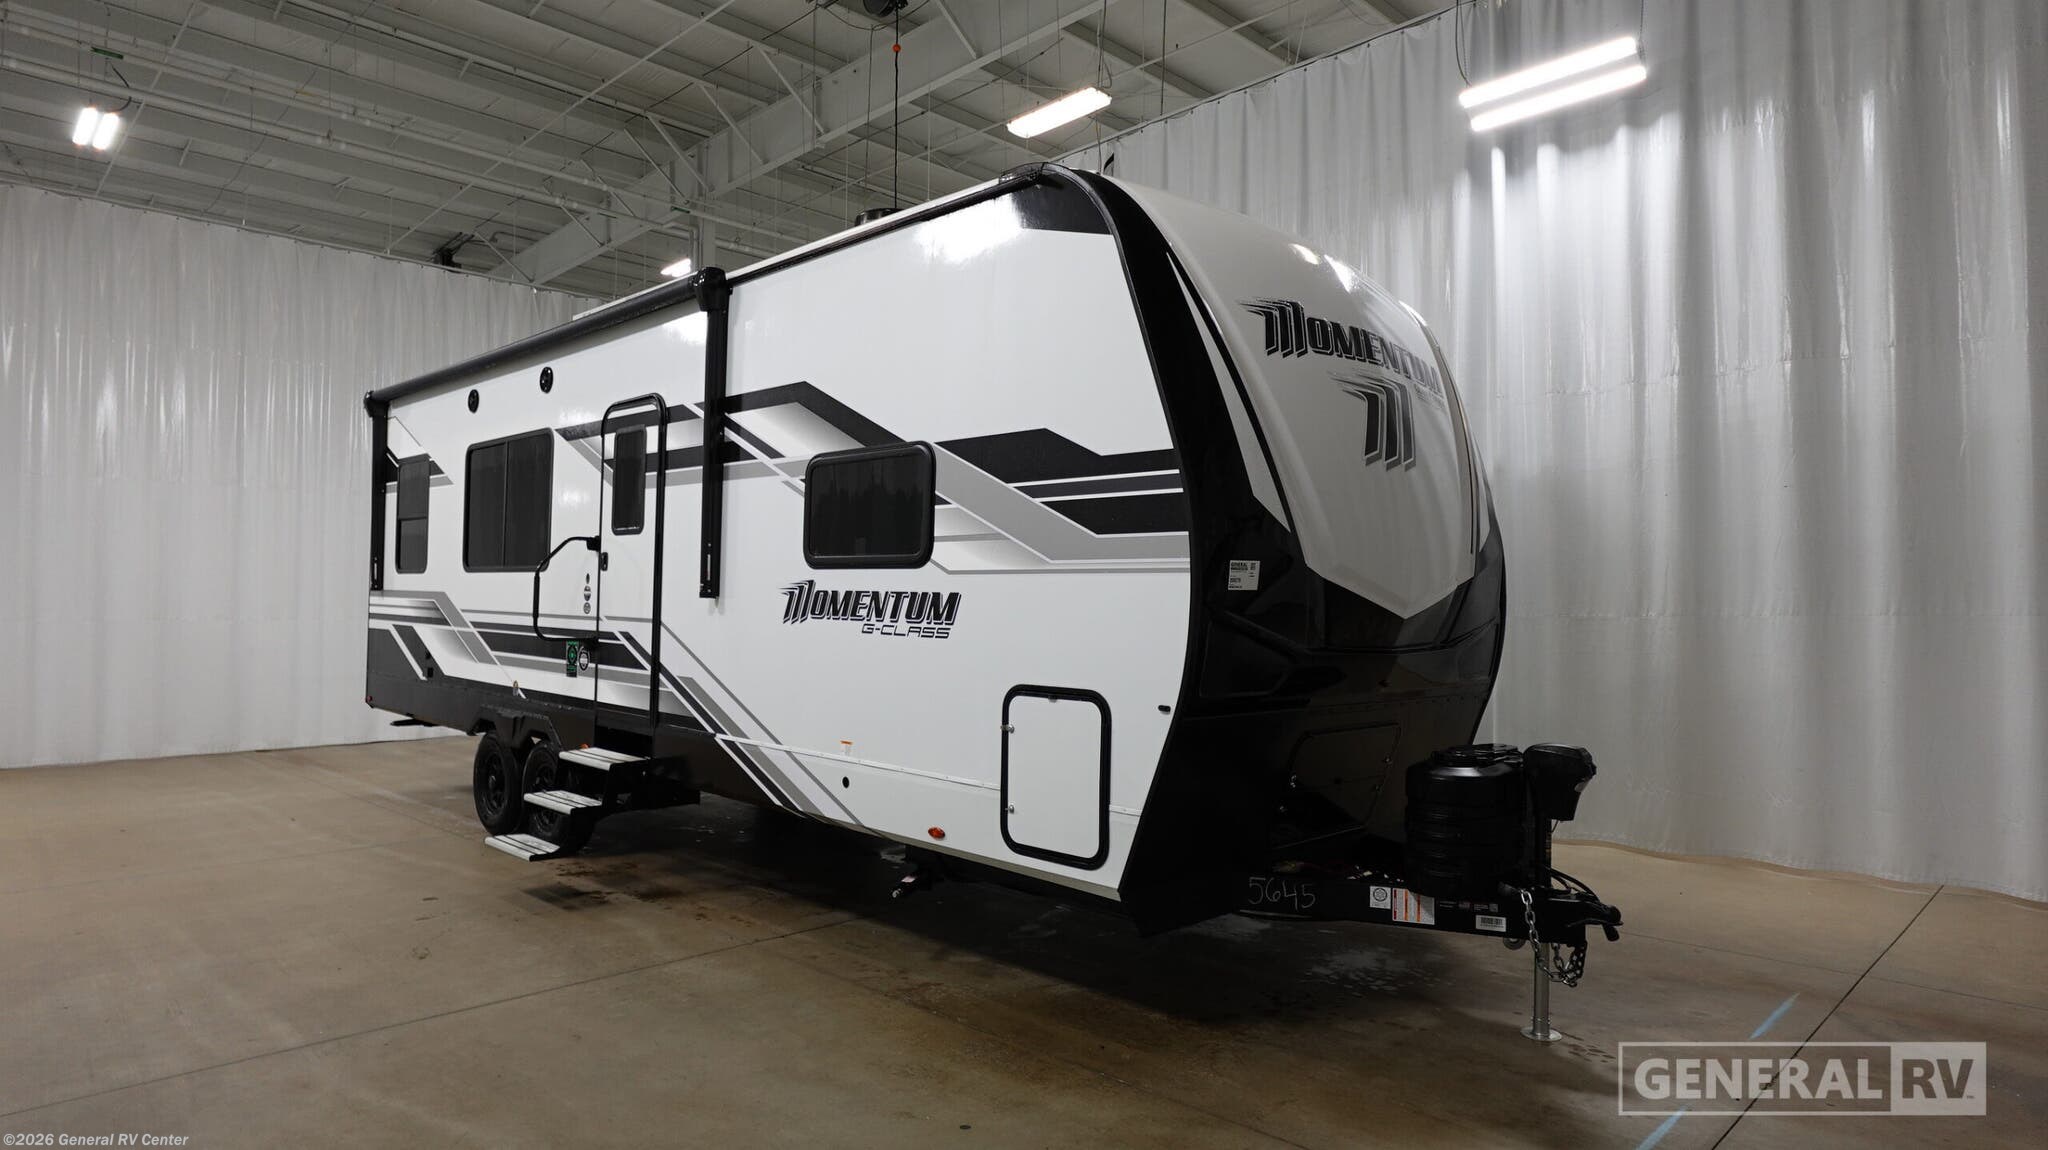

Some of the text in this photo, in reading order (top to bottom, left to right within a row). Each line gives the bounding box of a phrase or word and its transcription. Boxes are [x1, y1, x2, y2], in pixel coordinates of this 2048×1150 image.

[1239, 298, 1444, 397] MOMENTUM
[779, 580, 962, 625] MOMENTUM
[861, 623, 951, 639] G-CLASS
[1248, 876, 1316, 911] 5645
